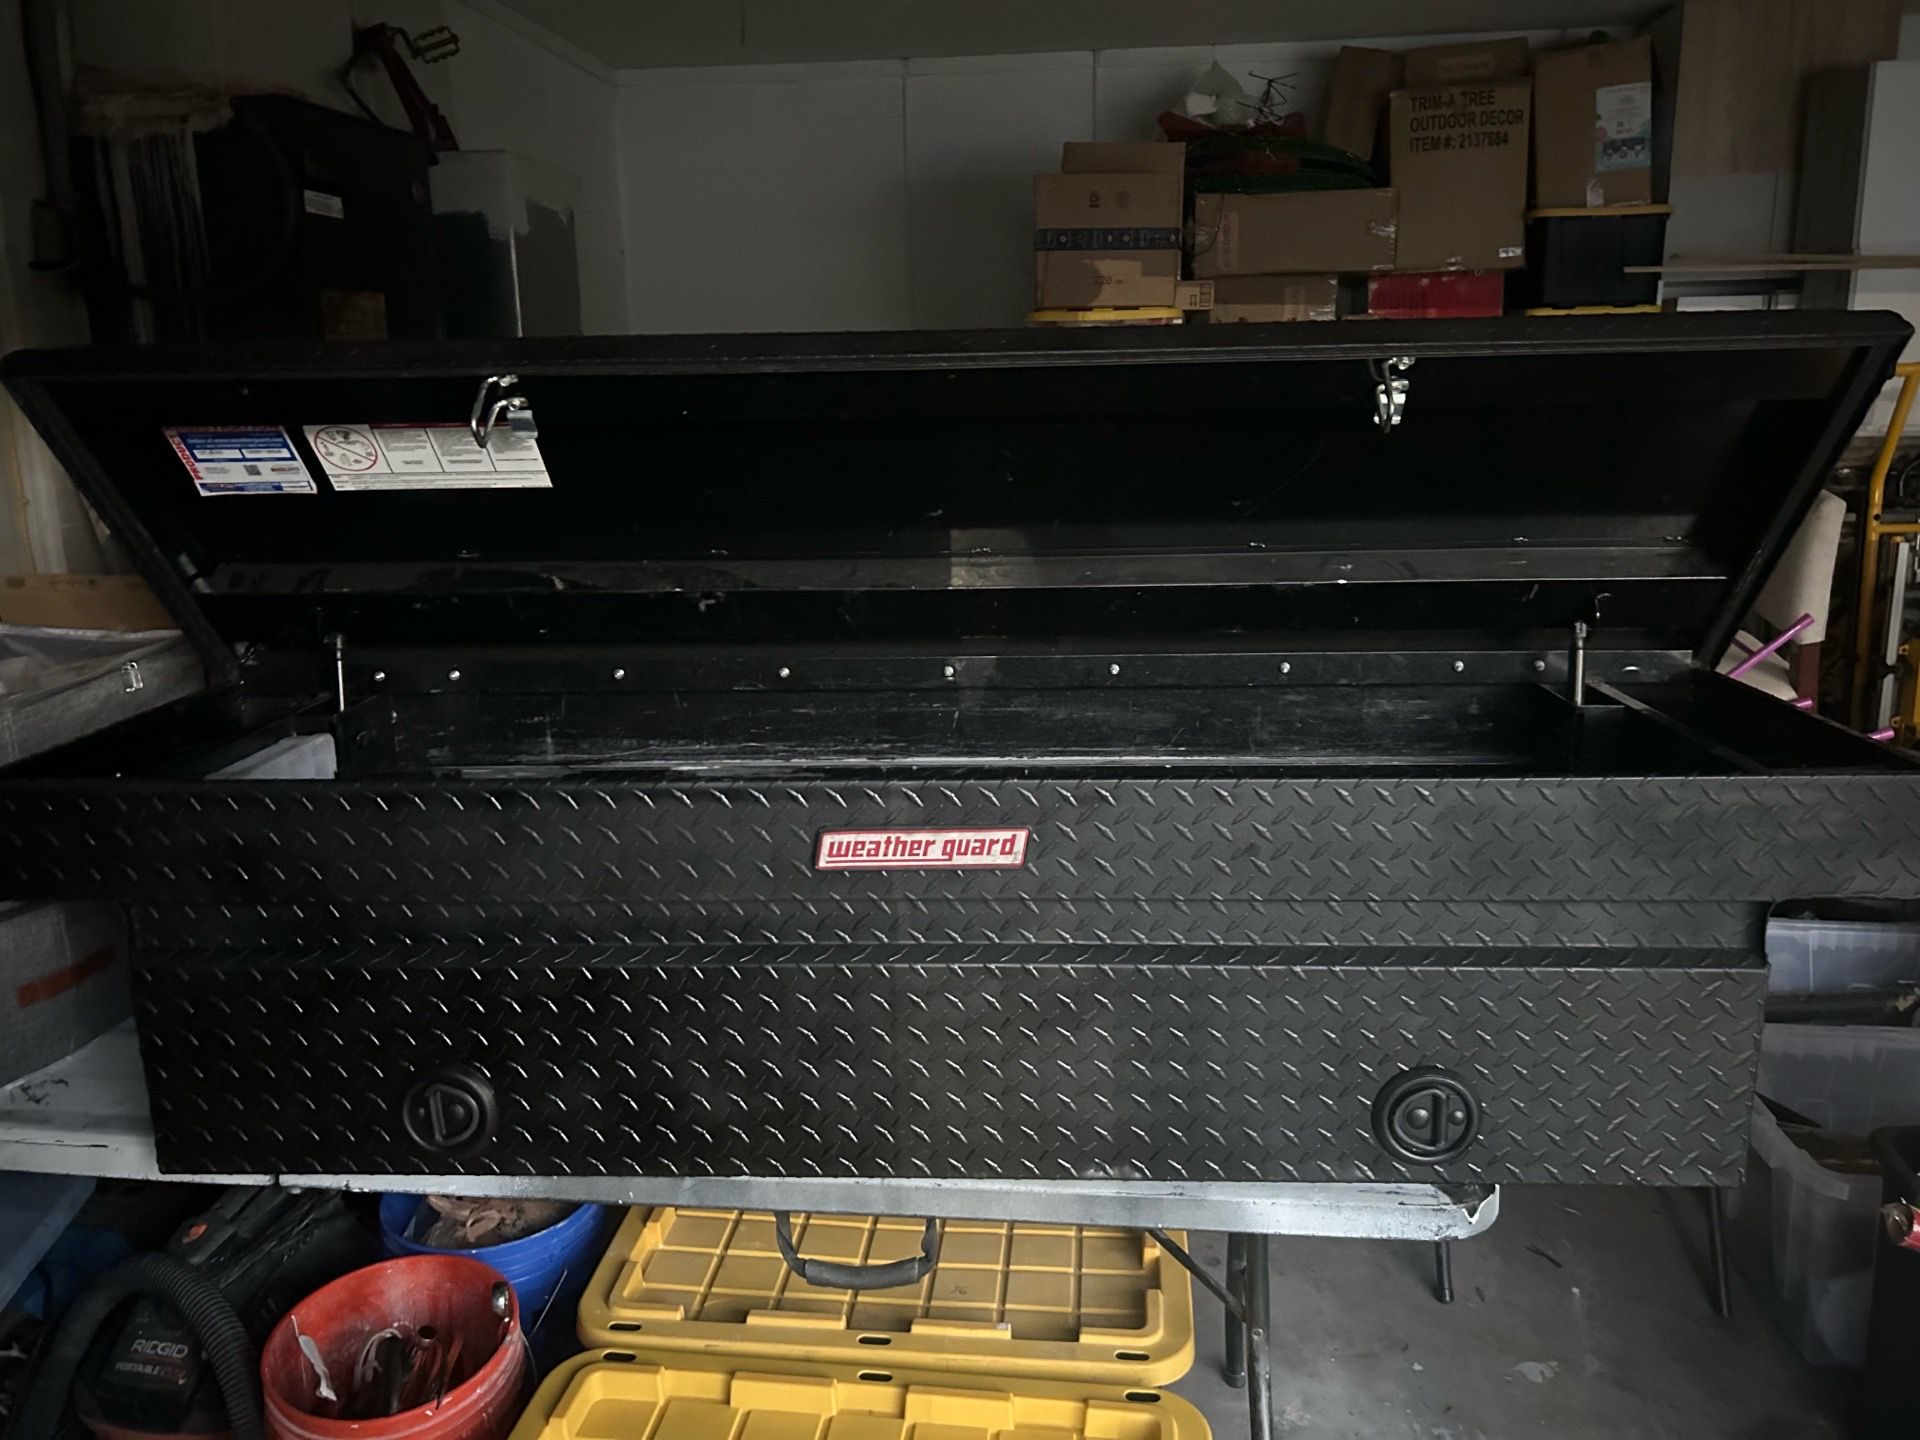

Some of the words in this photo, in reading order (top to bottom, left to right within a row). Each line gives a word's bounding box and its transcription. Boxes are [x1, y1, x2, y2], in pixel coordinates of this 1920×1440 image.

[1410, 94, 1455, 111] TRIM-A
[1460, 90, 1496, 106] TREE
[1410, 111, 1477, 132] OUTDOOR
[1480, 109, 1524, 126] DECOR
[827, 835, 936, 858] weather
[942, 833, 1017, 861] guard
[129, 1338, 189, 1358] RIDGID
